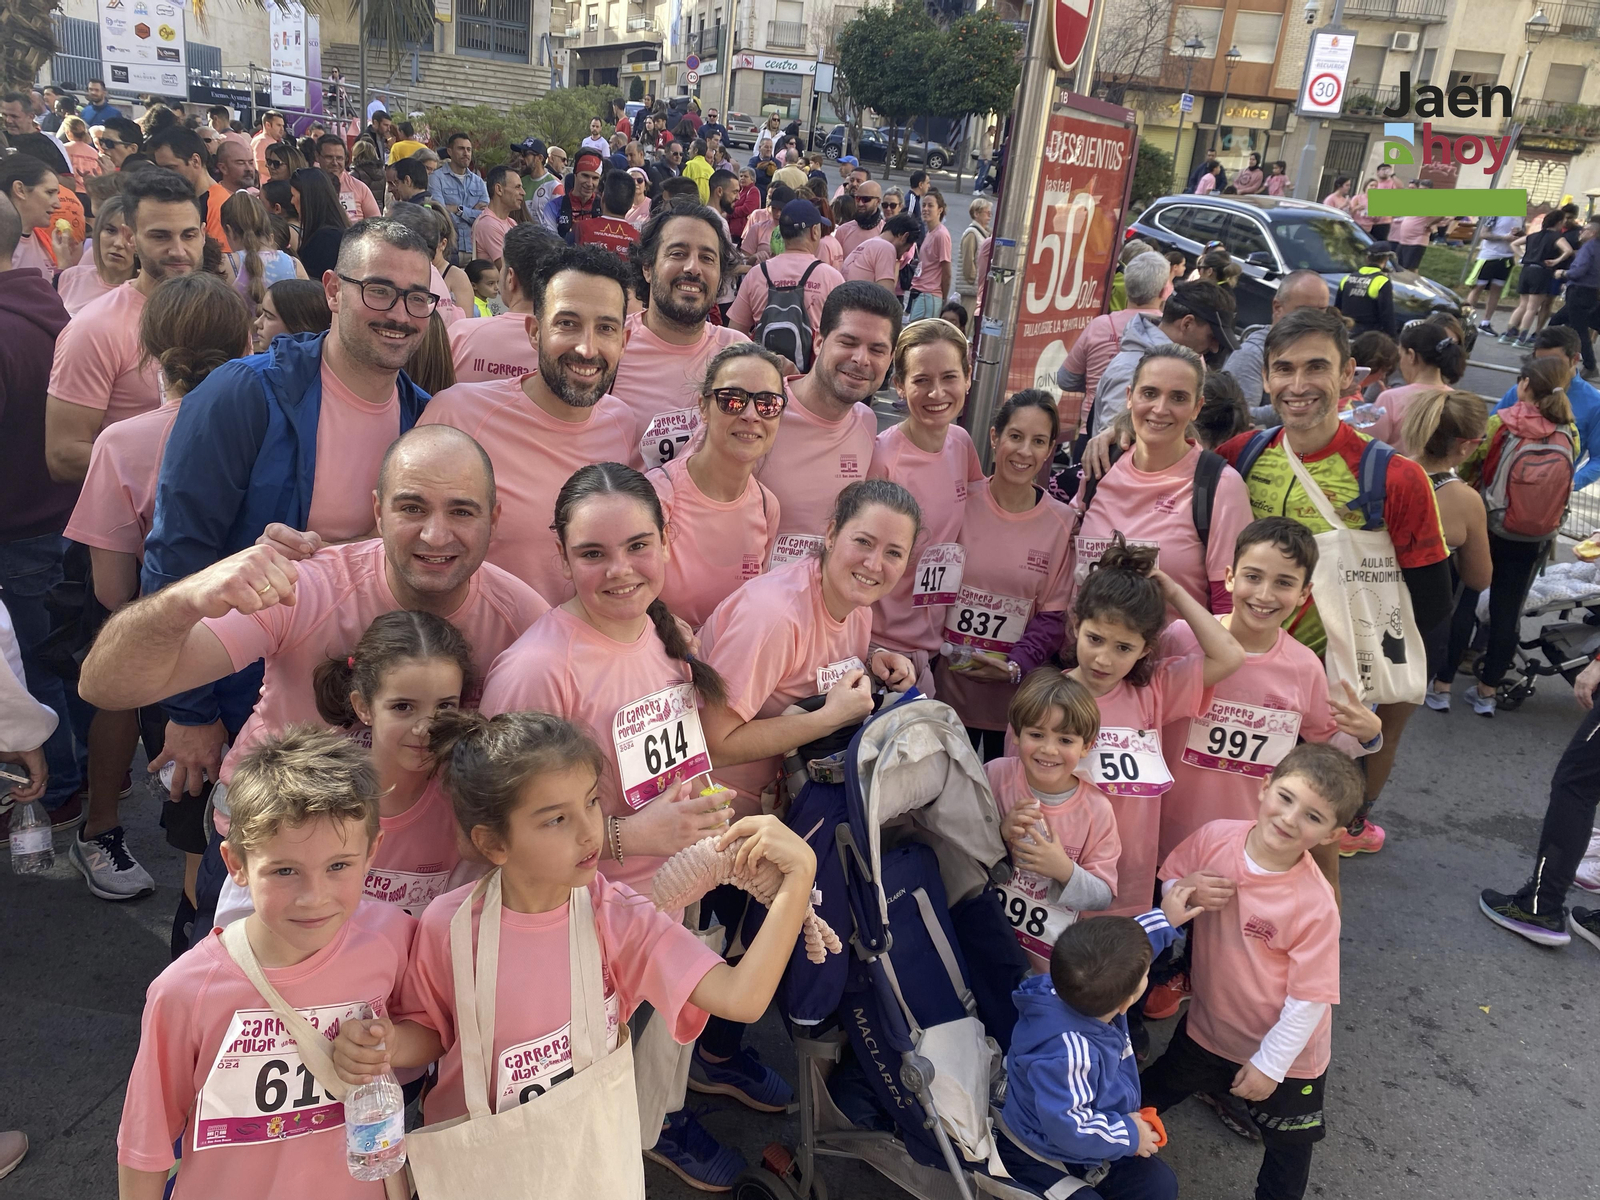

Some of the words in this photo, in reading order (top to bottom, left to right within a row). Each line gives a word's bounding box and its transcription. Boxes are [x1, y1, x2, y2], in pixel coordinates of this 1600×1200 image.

[765, 60, 798, 70] centro
[1315, 82, 1335, 97] 30
[1361, 558, 1383, 568] AULA
[1385, 557, 1395, 568] DE
[920, 566, 946, 592] 417
[957, 608, 1007, 638] 837
[644, 720, 689, 775] 614
[1207, 726, 1269, 762] 997
[1099, 752, 1139, 781] 50
[255, 1059, 340, 1113] 61
